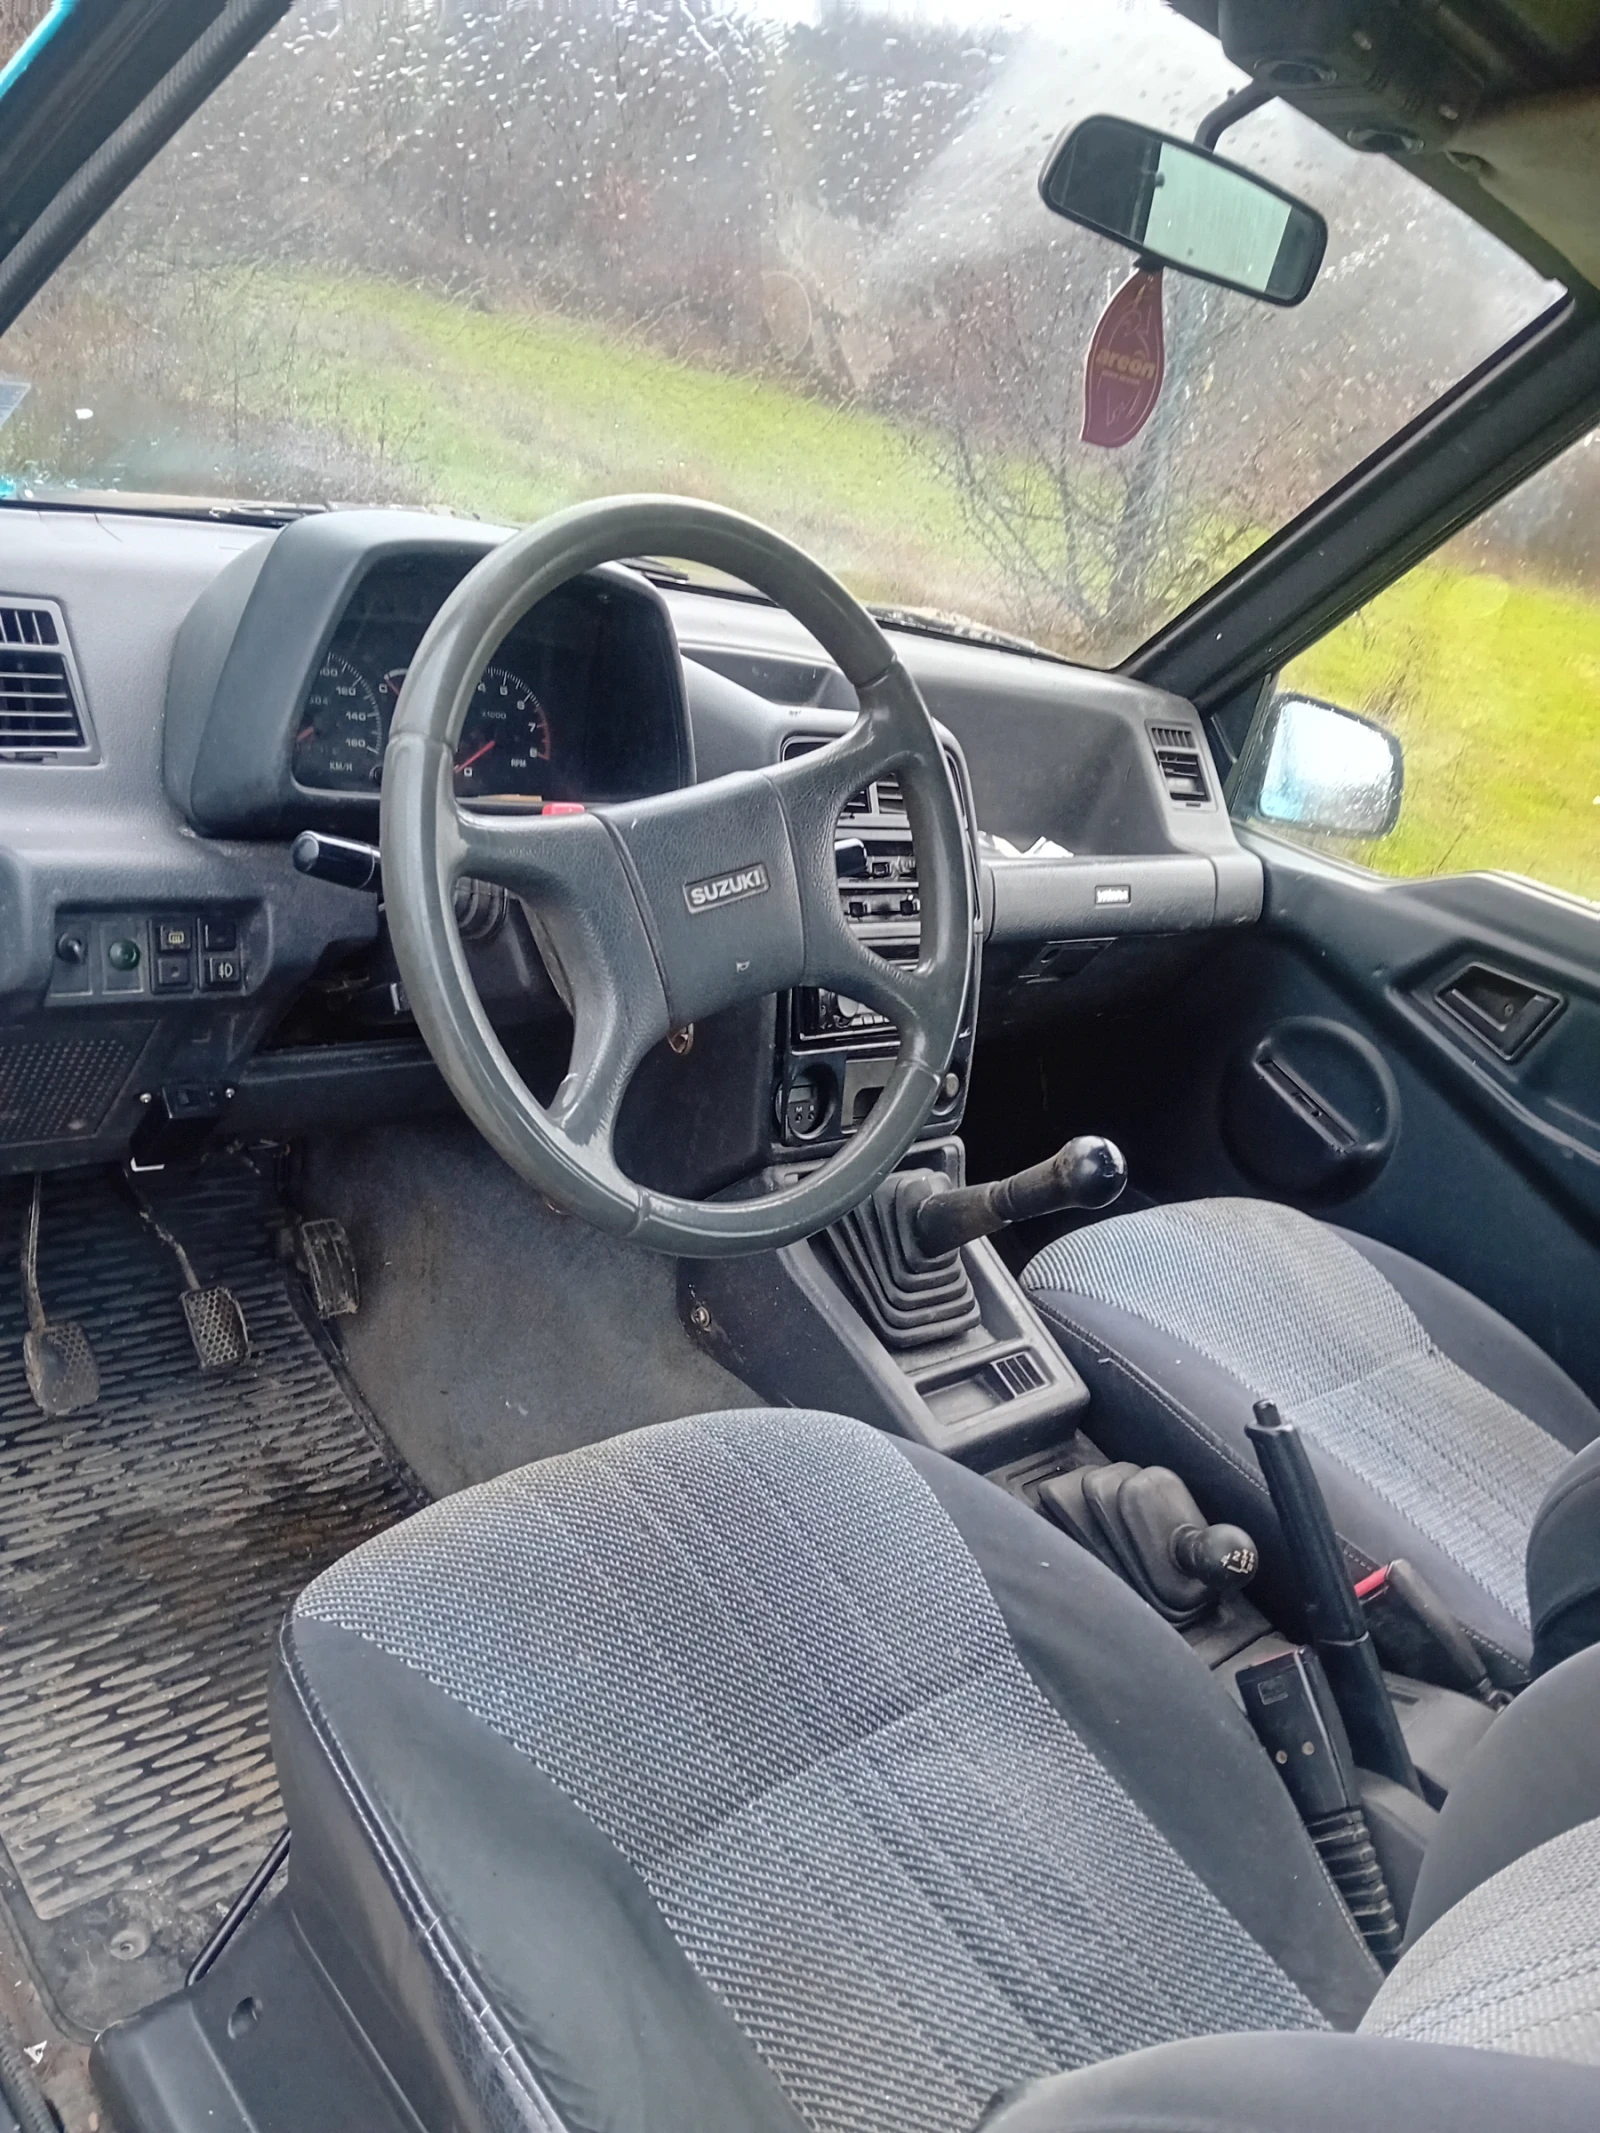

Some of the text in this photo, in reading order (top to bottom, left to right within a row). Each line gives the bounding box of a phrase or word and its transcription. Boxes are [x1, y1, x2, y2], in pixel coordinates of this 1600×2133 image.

[346, 711, 366, 721] 140
[528, 722, 536, 732] 7
[463, 767, 473, 777] 0
[691, 870, 761, 905] SUZUKI
